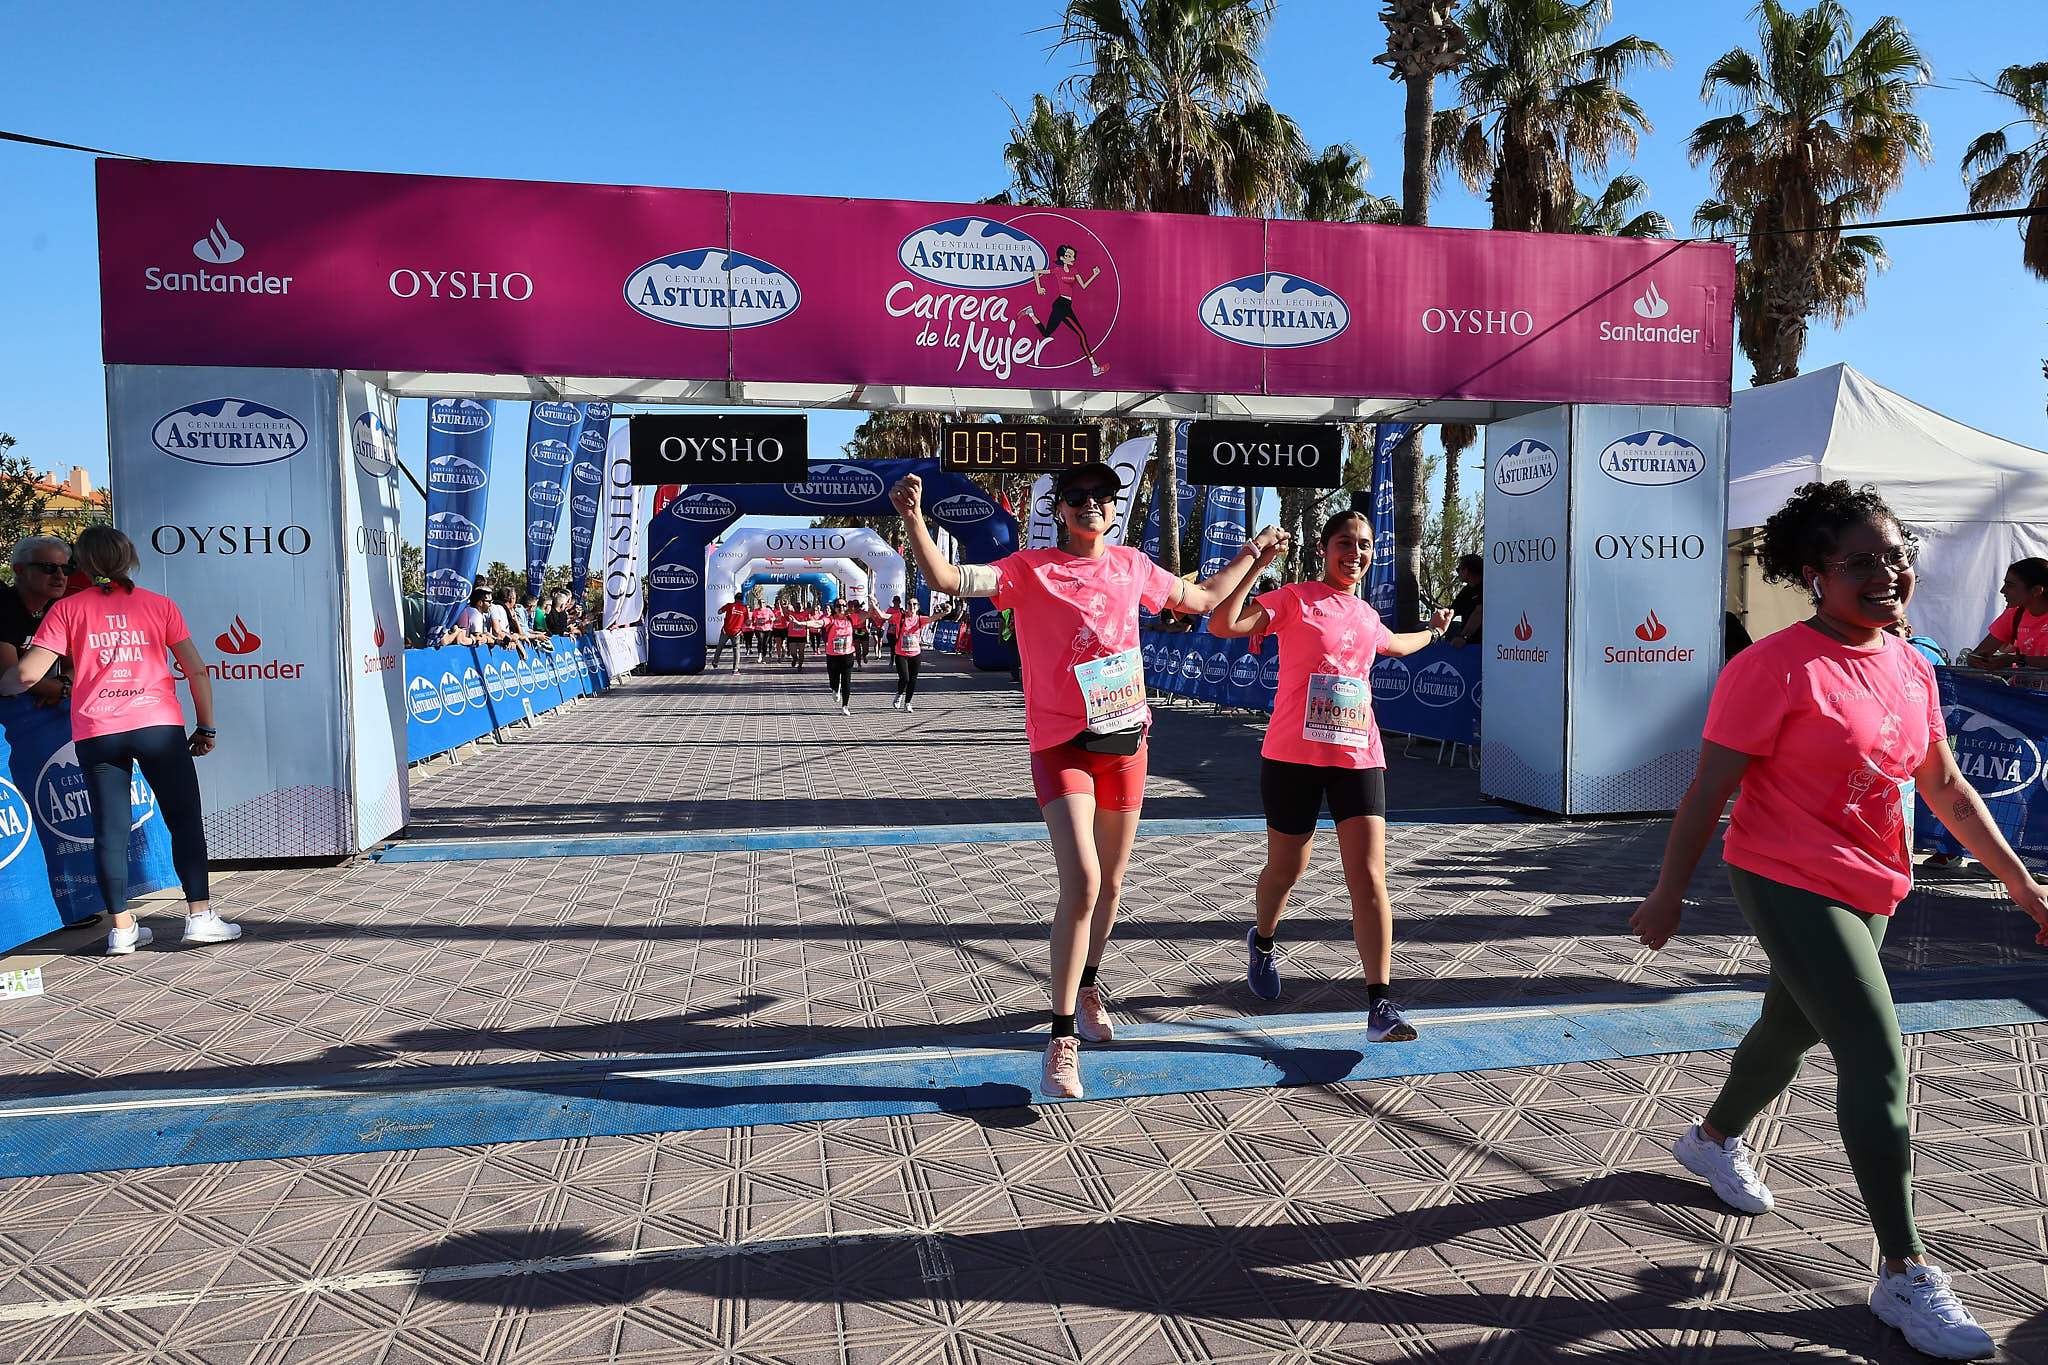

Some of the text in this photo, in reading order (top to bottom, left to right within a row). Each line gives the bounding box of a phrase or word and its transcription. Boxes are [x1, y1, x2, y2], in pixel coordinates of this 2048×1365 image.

[933, 240, 1033, 252] CENTRAL LECHERA
[910, 240, 1037, 273] ASTURIANA
[144, 266, 293, 295] Santander
[388, 269, 534, 301] OYSHO
[665, 275, 721, 285] CENTRAL
[638, 276, 787, 310] ASTURIANA
[885, 280, 1009, 322] Carrera
[1210, 298, 1338, 329] ASTURIANA
[1286, 299, 1334, 308] LECHERA
[1422, 307, 1534, 335] OYSHO
[1599, 321, 1701, 345] Santander
[916, 320, 1055, 380] de la Mujer
[187, 421, 292, 430] CENTRAL LECHERA
[164, 422, 297, 450] ASTURIANA
[660, 437, 784, 463] OYSHO
[952, 431, 1088, 465] 00:57:15
[1212, 441, 1320, 468] OYSHO
[1623, 449, 1694, 458] CENTRAL LECHERA
[1607, 451, 1697, 473] ASTURIANA
[1497, 462, 1553, 486] ASTURIANA
[792, 483, 877, 495] ASTURIANA
[676, 503, 731, 516] ASTURIANA
[937, 505, 990, 517] ASTURIANA
[151, 525, 312, 555] OYSHO
[766, 534, 846, 550] OYSHO
[1595, 534, 1705, 560] OYSHO
[1493, 536, 1556, 565] OYSHO
[651, 574, 695, 585] ASTURIANA
[105, 614, 127, 630] TU
[651, 620, 694, 632] ASTURIANA
[88, 630, 150, 649] DORSAL
[100, 646, 144, 665] SUMA
[1496, 644, 1548, 663] Santander
[1604, 646, 1696, 664] Santander
[112, 669, 132, 679] 2024
[173, 659, 305, 681] Sntander
[98, 687, 145, 699] Cotano
[1964, 737, 2023, 754] LECHERA
